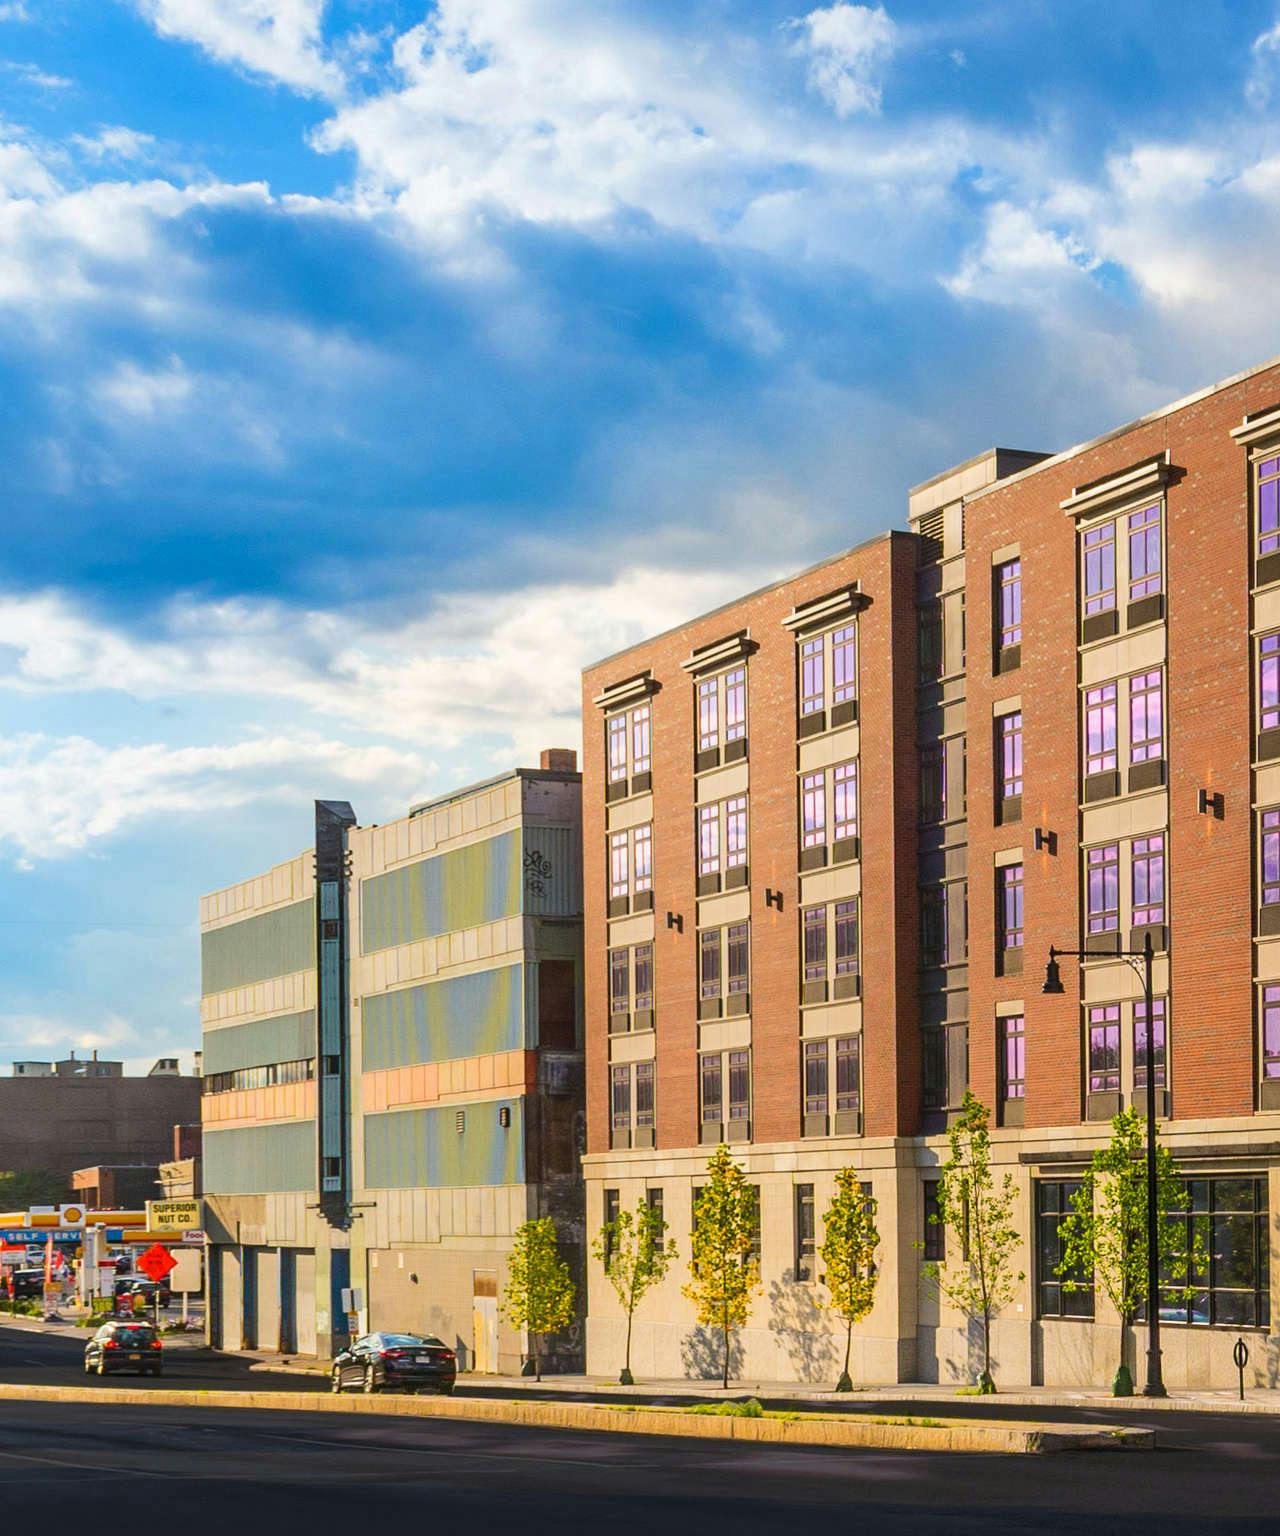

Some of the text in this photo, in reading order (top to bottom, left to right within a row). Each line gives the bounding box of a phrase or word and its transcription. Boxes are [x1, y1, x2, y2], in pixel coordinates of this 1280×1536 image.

[153, 1203, 198, 1213] SUPERIOR
[158, 1214, 194, 1223] NUT CO.
[8, 1232, 39, 1240] SELF
